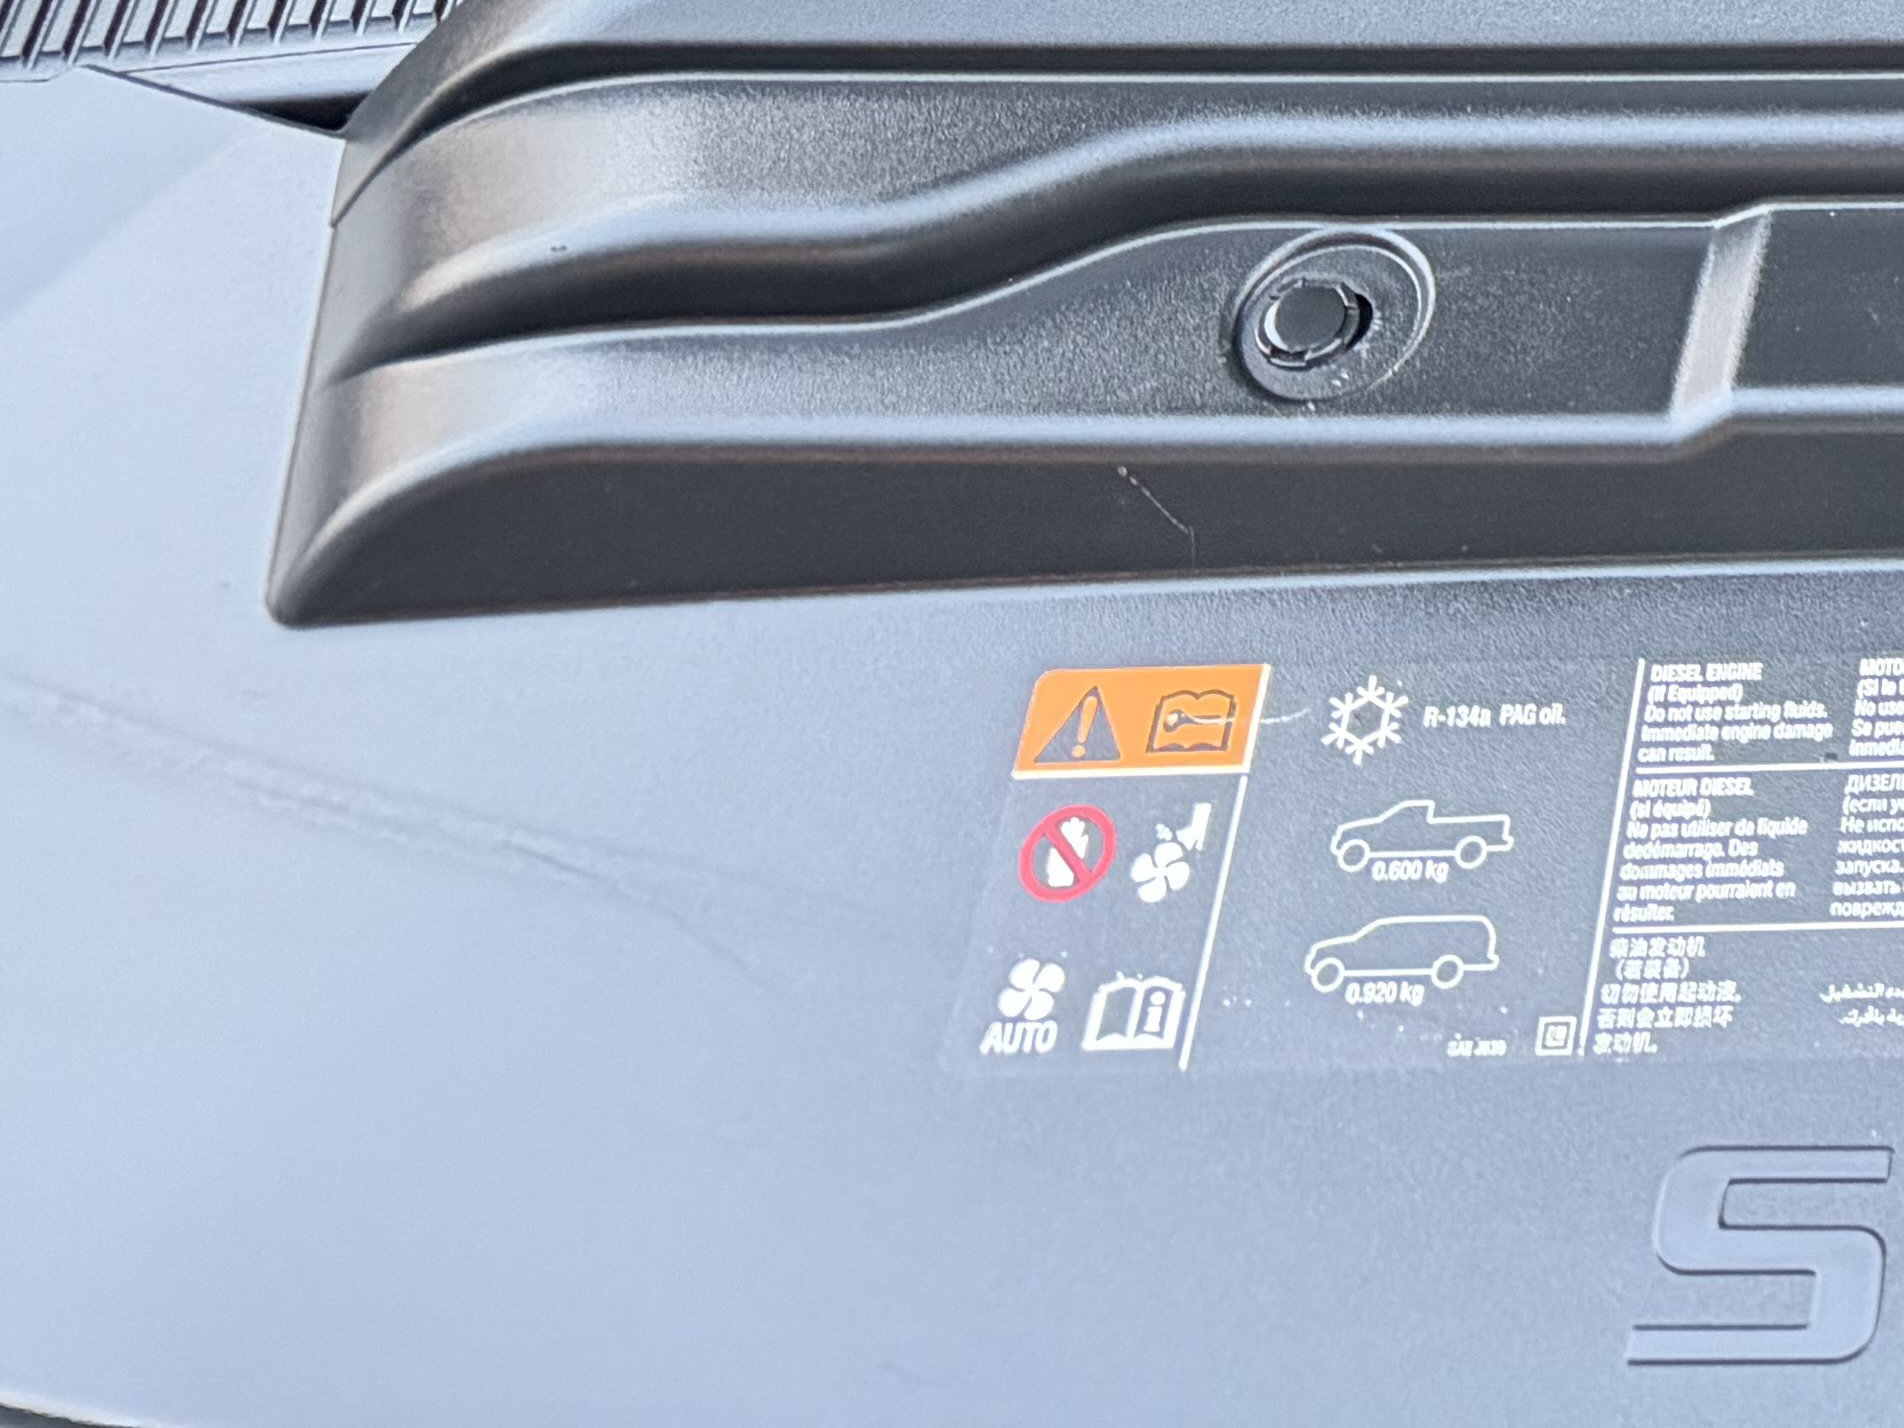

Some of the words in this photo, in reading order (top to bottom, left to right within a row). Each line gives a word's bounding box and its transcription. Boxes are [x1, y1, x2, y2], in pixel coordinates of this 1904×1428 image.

[1651, 664, 1703, 682] DIESEL
[1706, 662, 1763, 681] ENGINE
[1668, 683, 1743, 704] Equipped)
[1424, 705, 1490, 728] R-134a
[1501, 704, 1536, 727] PAG
[1539, 702, 1566, 726] oil.
[1645, 705, 1664, 722] Do
[1668, 704, 1692, 721] not
[1695, 706, 1722, 721] use
[1725, 702, 1781, 723] starting
[1783, 701, 1828, 719] fluids.
[1855, 699, 1875, 716] No
[1879, 701, 1904, 715] use
[1641, 724, 1719, 742] Immediate
[1722, 722, 1771, 743] engine
[1774, 722, 1833, 742] damage
[1851, 719, 1872, 736] Se
[1638, 747, 1666, 762] can
[1668, 744, 1715, 761] result.
[1633, 779, 1698, 797] MOTEUR
[1700, 777, 1754, 796] DIESEL
[1653, 798, 1711, 820] équipé)
[1842, 795, 1887, 815] (если
[1627, 822, 1648, 838] Ne
[1651, 823, 1678, 840] pas
[1681, 819, 1732, 837] utiliser
[1735, 819, 1754, 836] de
[1757, 817, 1808, 839] liquide
[1840, 816, 1864, 833] Не
[1728, 839, 1758, 856] Des
[1371, 862, 1422, 882] 0.600
[1426, 861, 1448, 884] kg
[1620, 863, 1703, 882] dommages
[1706, 859, 1785, 878] immédiats
[1617, 887, 1637, 901] au
[1640, 884, 1694, 900] moteur
[1696, 881, 1773, 902] pourraient
[1776, 882, 1796, 897] en
[1833, 880, 1900, 896] вызвать
[1613, 904, 1675, 922] résulter.
[1346, 984, 1396, 1004] 0.920
[1400, 983, 1424, 1006] kg
[981, 1021, 1058, 1054] AUTO
